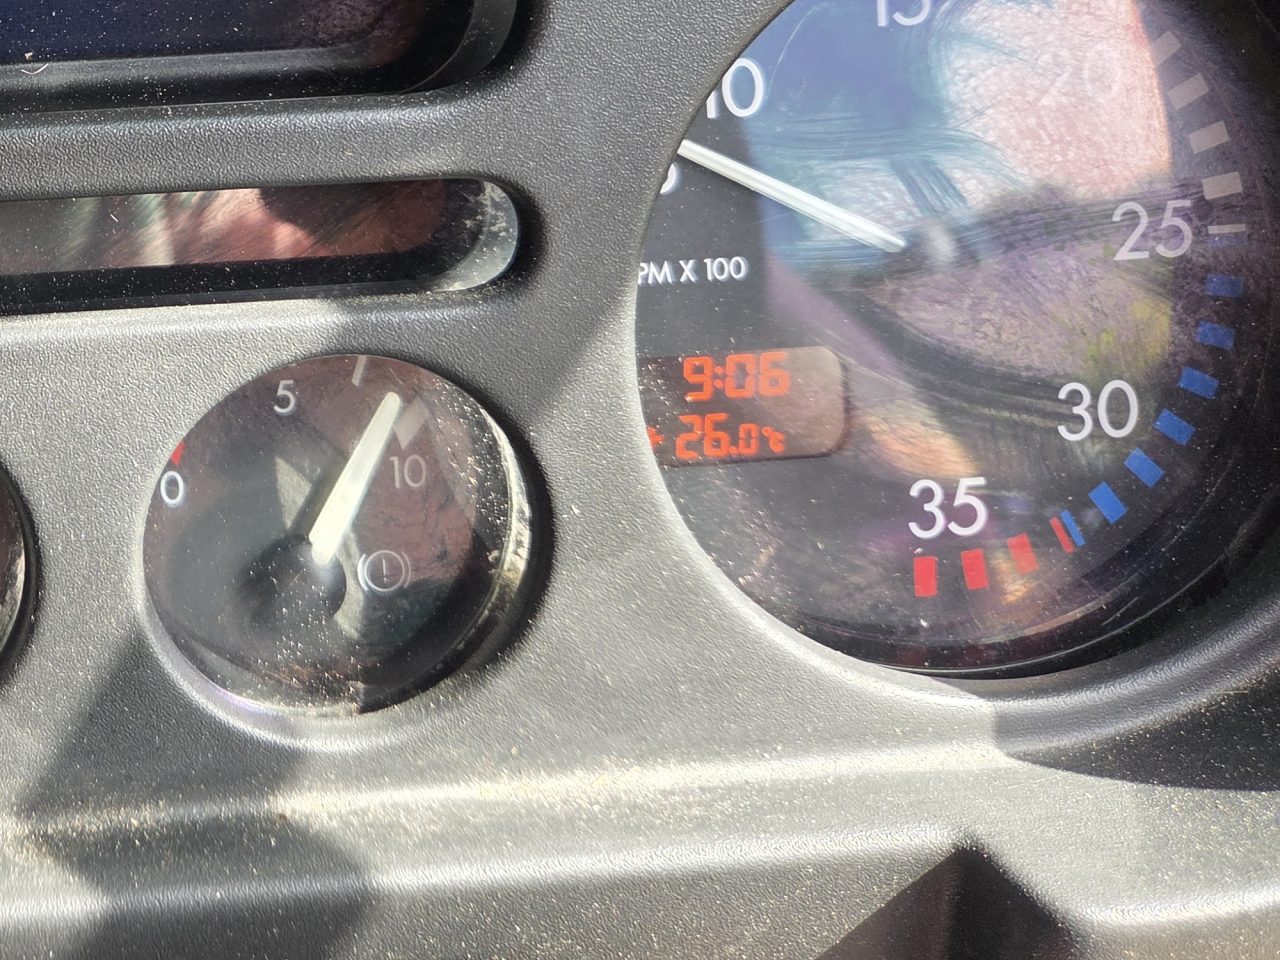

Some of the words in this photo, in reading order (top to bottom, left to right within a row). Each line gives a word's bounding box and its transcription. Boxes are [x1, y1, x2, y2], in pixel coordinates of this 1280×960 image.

[1111, 199, 1193, 261] 25
[679, 259, 697, 283] X
[703, 256, 748, 282] 100
[273, 380, 296, 414] 5
[683, 352, 790, 402] 9:06
[1057, 379, 1139, 441] 30
[160, 471, 184, 505] 0
[390, 455, 426, 489] 10
[908, 477, 988, 539] 35
